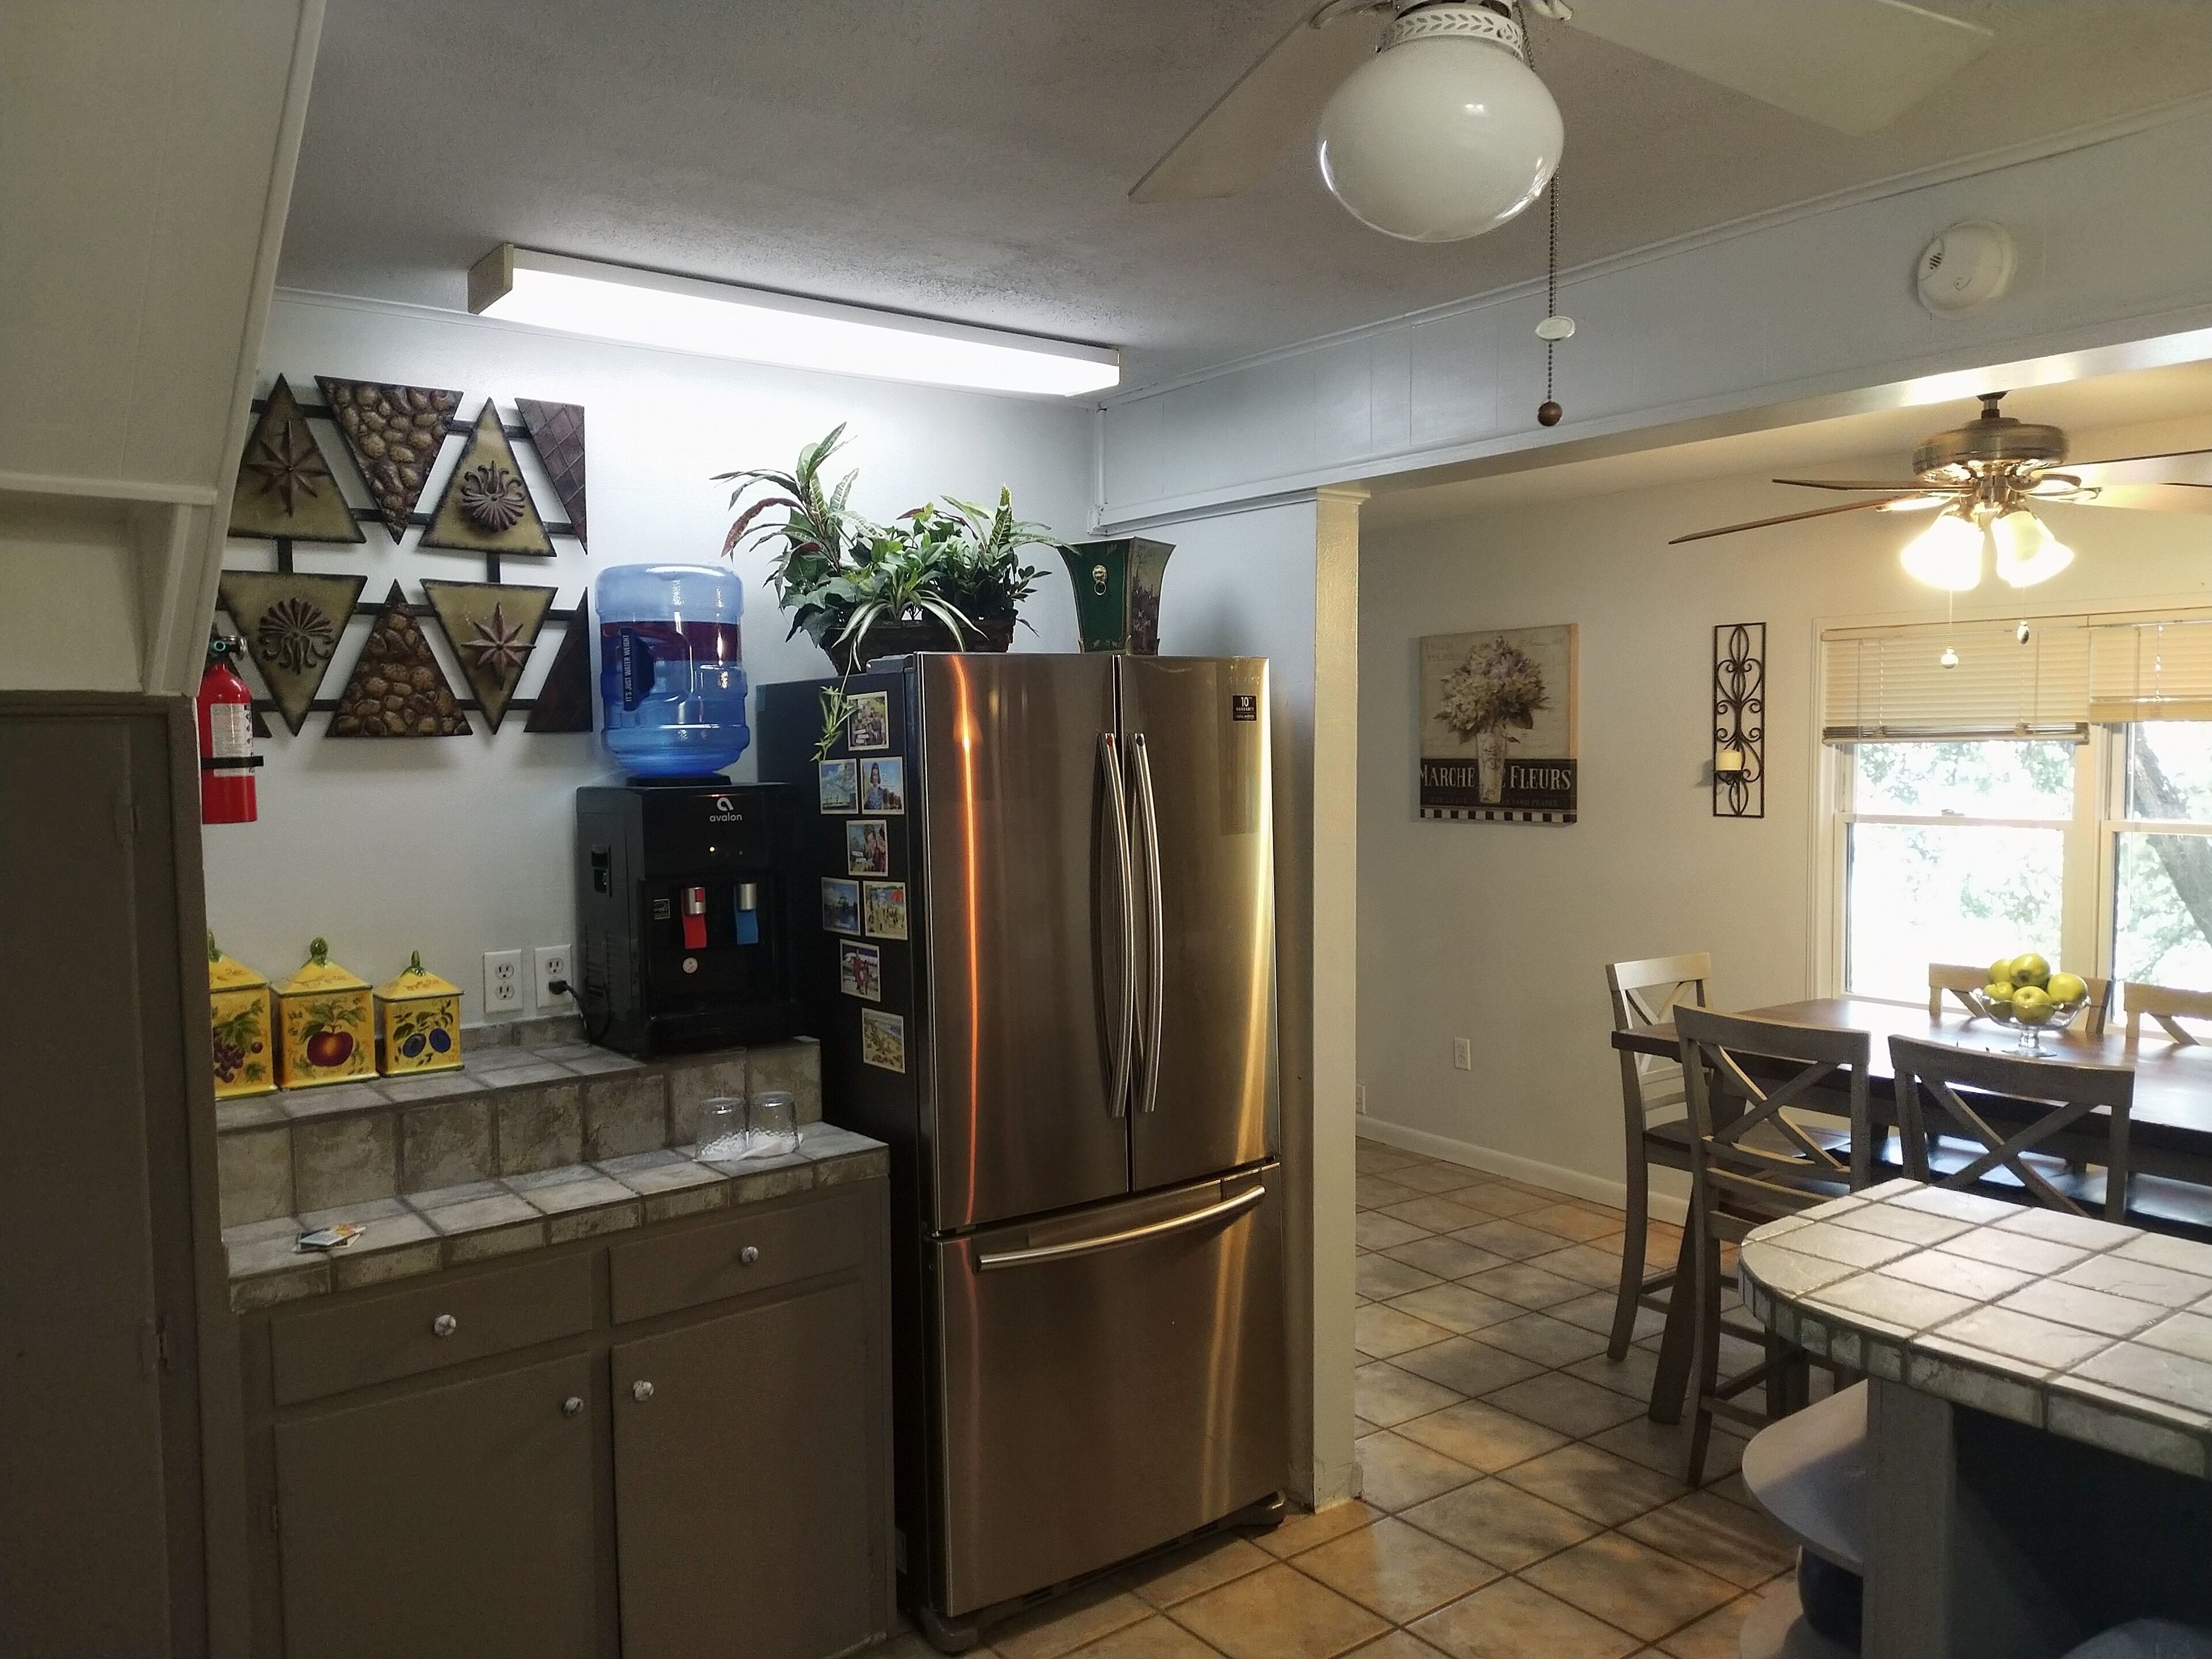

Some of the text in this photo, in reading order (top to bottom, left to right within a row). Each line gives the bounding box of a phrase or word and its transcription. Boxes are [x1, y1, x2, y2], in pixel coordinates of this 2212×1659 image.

[1240, 696, 1249, 707] 10
[1510, 765, 1571, 790] FLEURS
[709, 812, 743, 822] avalon
